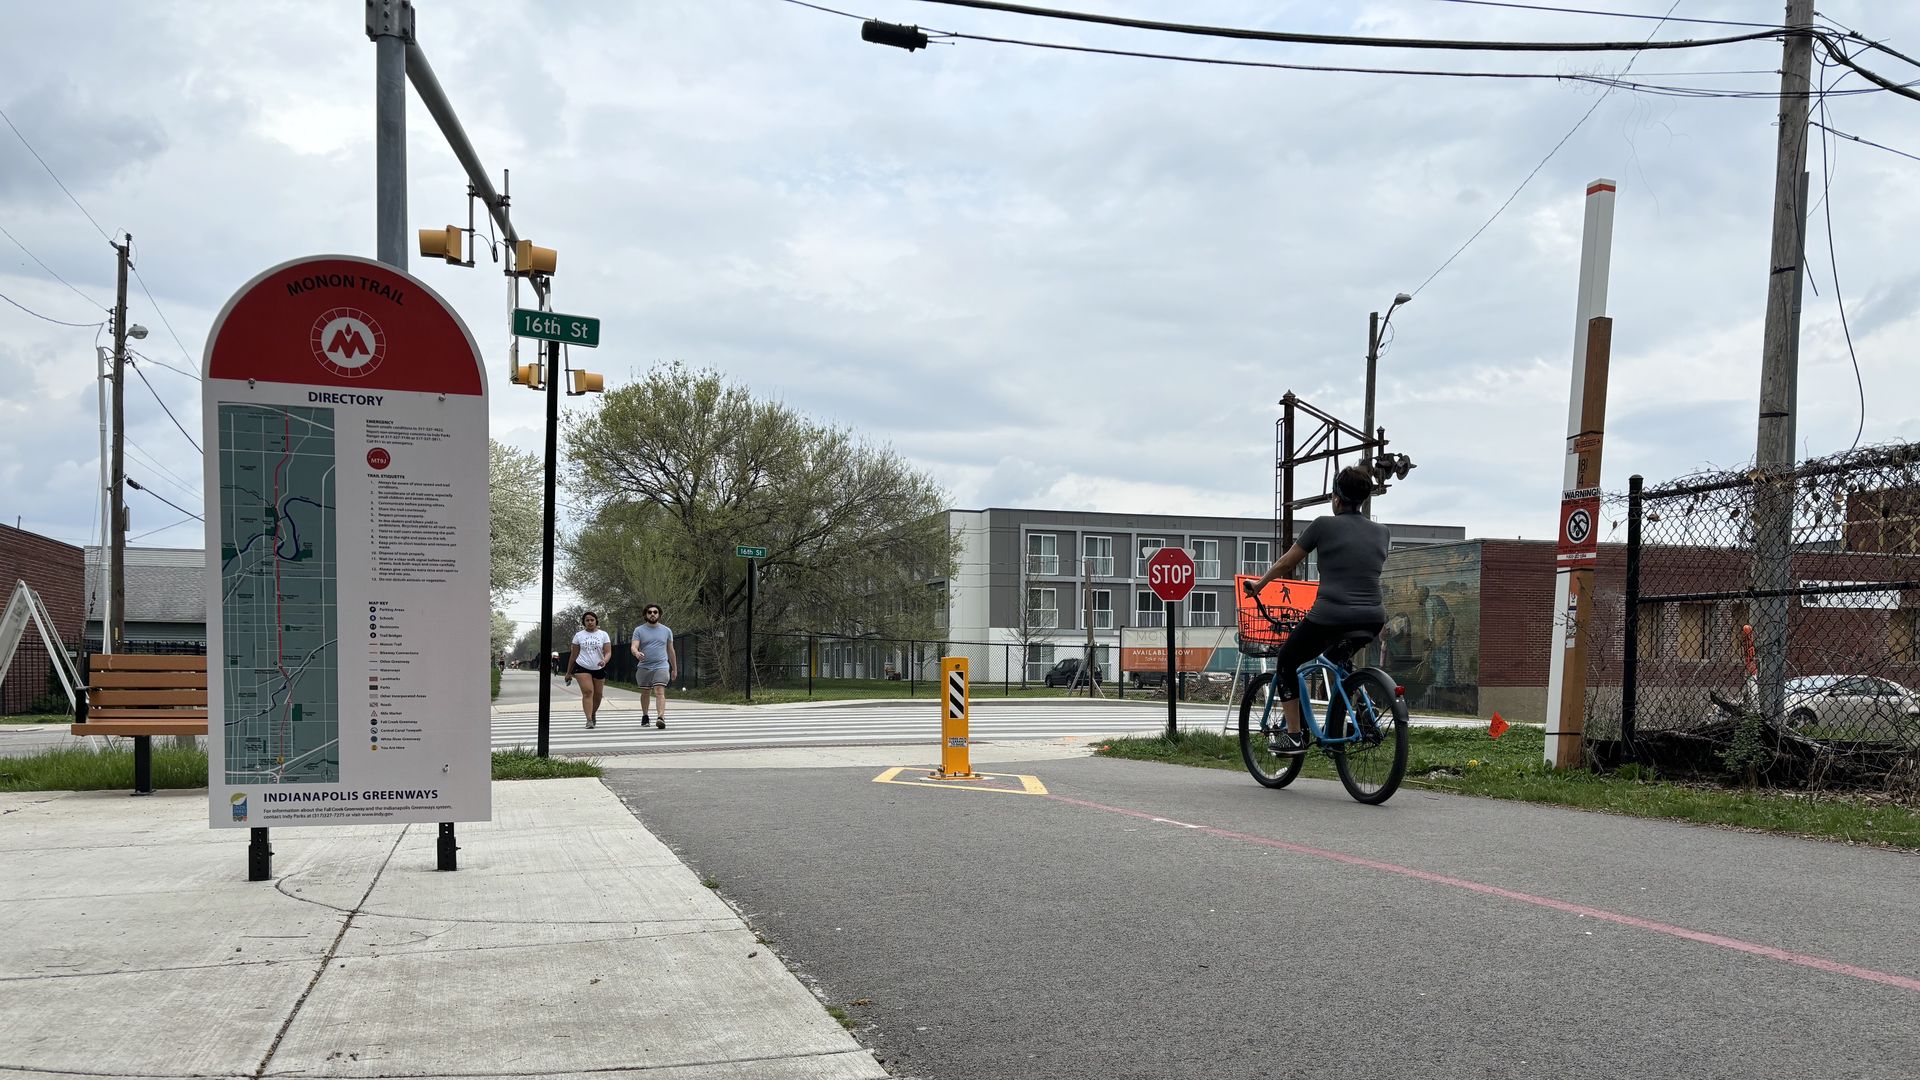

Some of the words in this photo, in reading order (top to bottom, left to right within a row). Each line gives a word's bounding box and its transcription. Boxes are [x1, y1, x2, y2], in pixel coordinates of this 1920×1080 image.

[286, 274, 355, 296] MONON
[360, 277, 405, 306] TRAIL
[525, 316, 560, 335] 16th
[570, 322, 588, 338] St
[308, 392, 383, 406] DIRECTORY
[1564, 489, 1599, 499] WARNING!
[1152, 564, 1191, 584] STOP
[264, 791, 358, 802] INDIANAPOLIS
[363, 790, 438, 800] GREENWAYS
